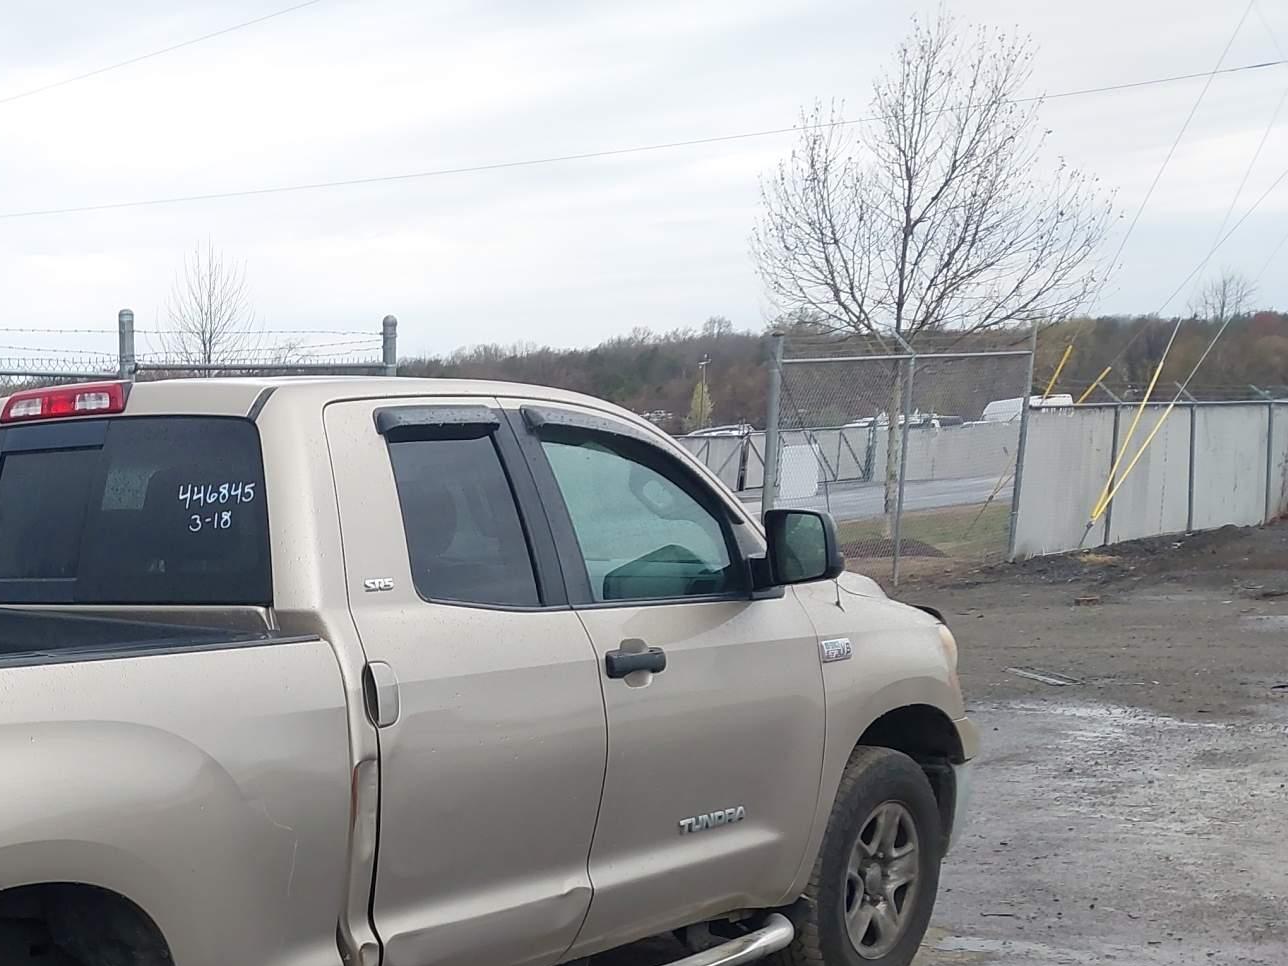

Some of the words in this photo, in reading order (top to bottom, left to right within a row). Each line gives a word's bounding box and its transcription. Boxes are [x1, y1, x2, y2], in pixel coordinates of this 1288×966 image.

[178, 482, 256, 510] 446845
[189, 510, 232, 532] 3-18
[364, 578, 394, 592] SR5
[679, 805, 746, 835] TUNDRA
